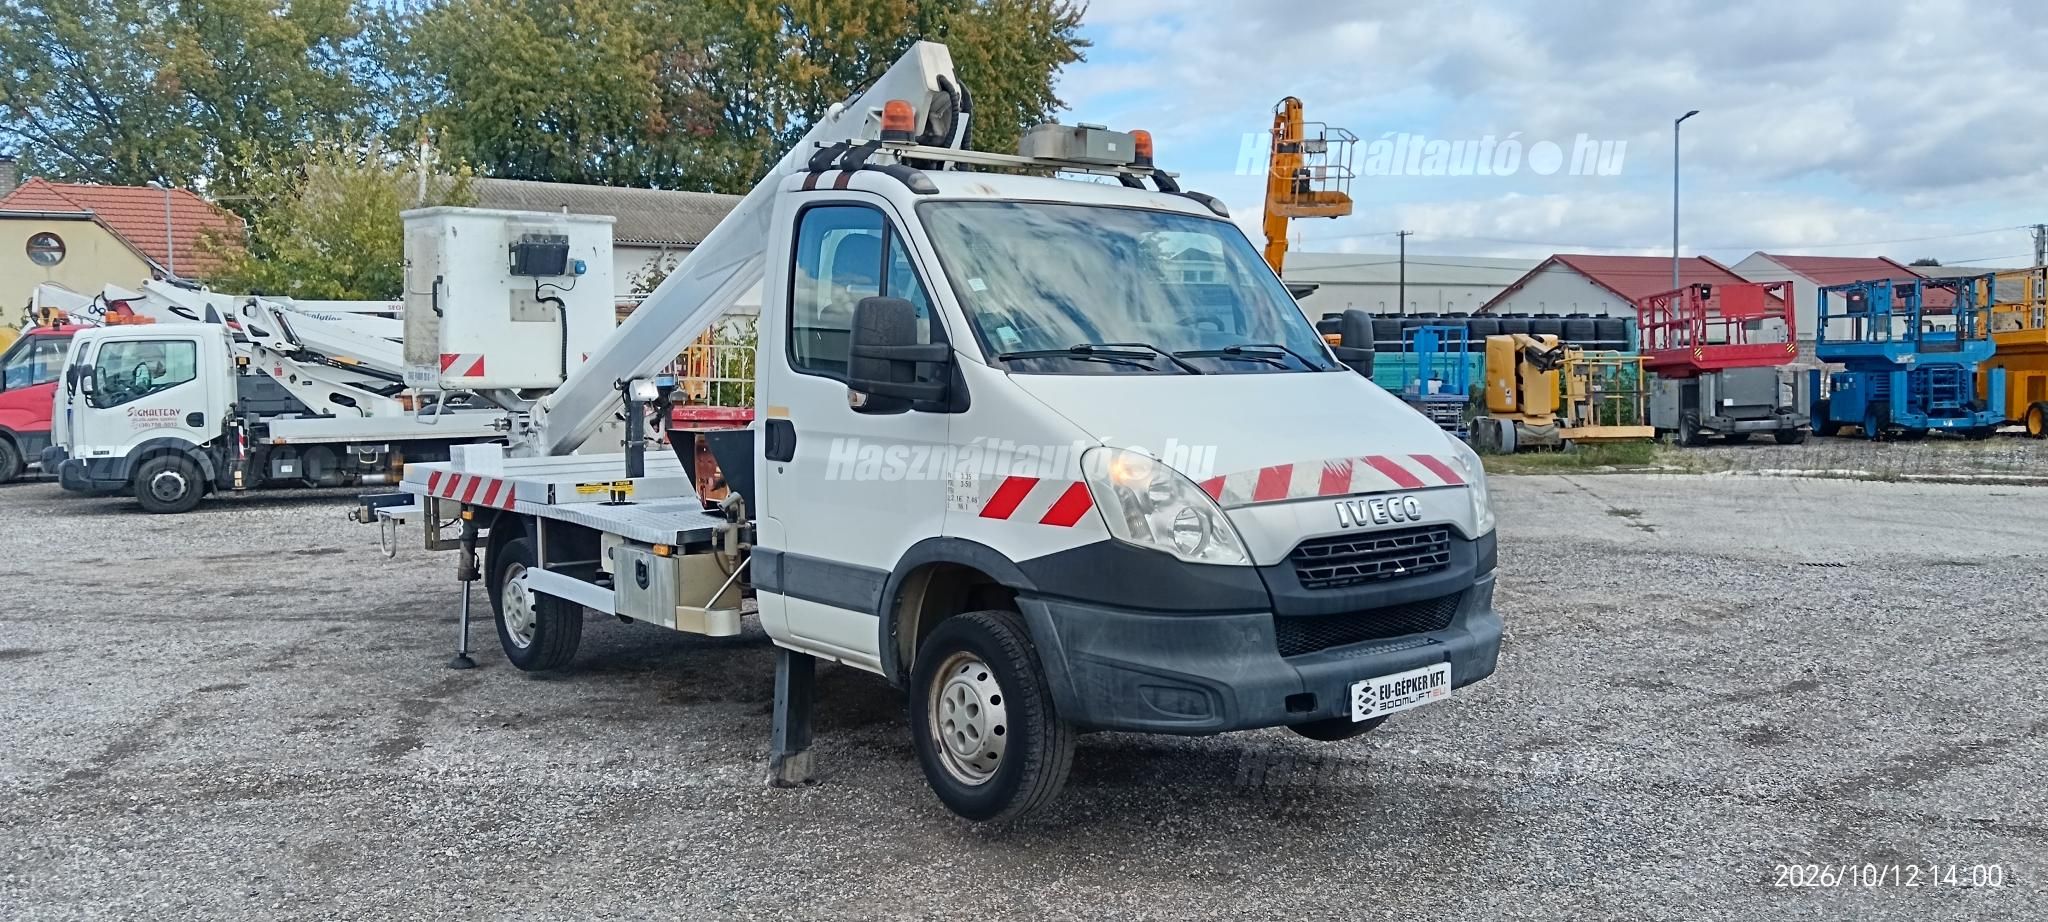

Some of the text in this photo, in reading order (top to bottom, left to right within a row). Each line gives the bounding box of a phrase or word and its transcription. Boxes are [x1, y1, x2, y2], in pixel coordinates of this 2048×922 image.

[1335, 496, 1422, 528] IVECO
[1379, 671, 1446, 700] EU-GÉPKER KFT.
